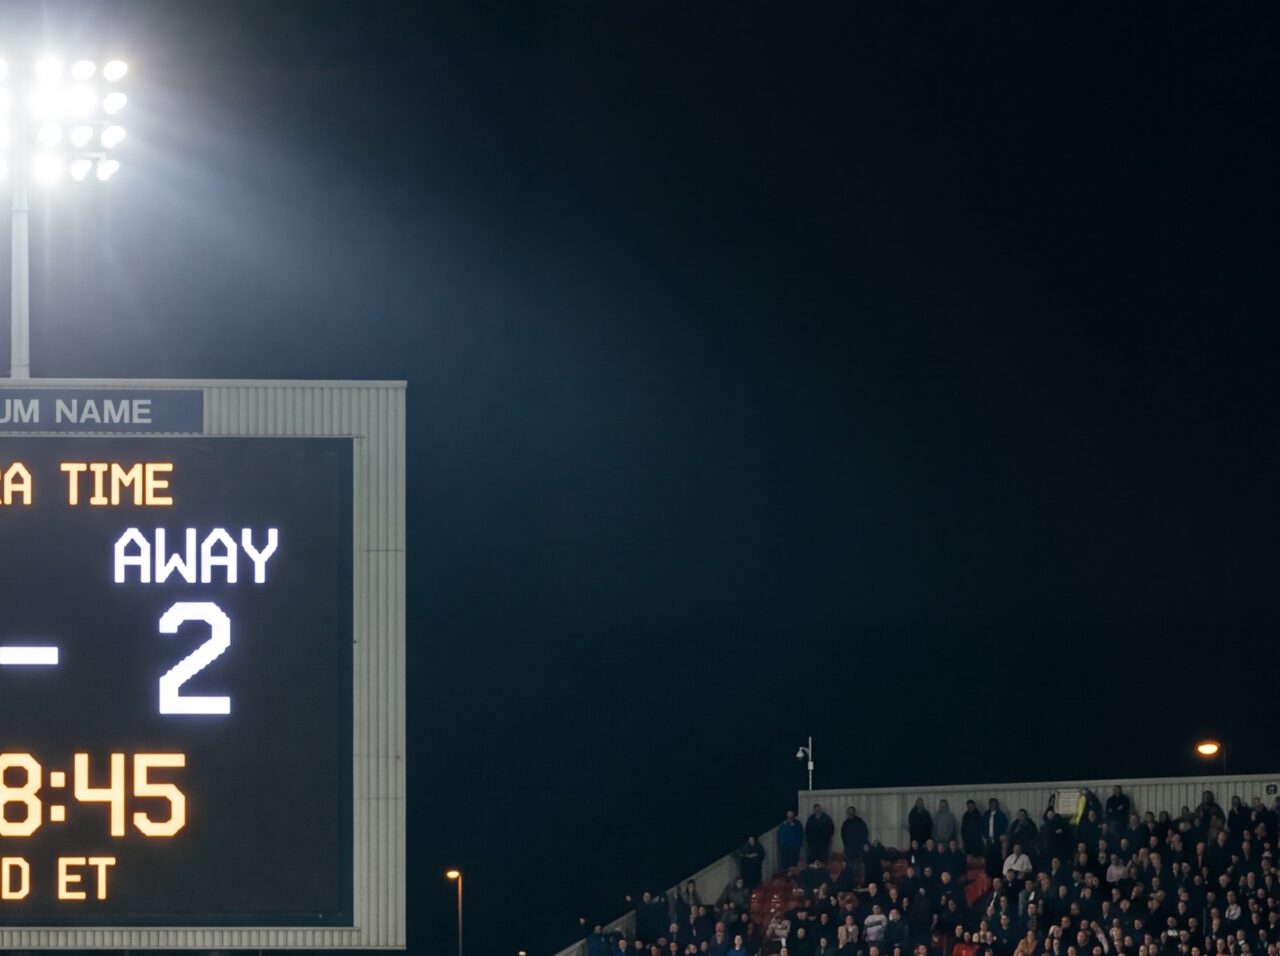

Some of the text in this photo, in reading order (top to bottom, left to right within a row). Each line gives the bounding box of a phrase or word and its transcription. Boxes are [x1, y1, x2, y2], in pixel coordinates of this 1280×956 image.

[55, 398, 153, 424] NAME
[60, 462, 174, 506] TIME
[114, 527, 279, 584] AWAY
[158, 601, 231, 715] 2
[58, 856, 116, 900] ET
